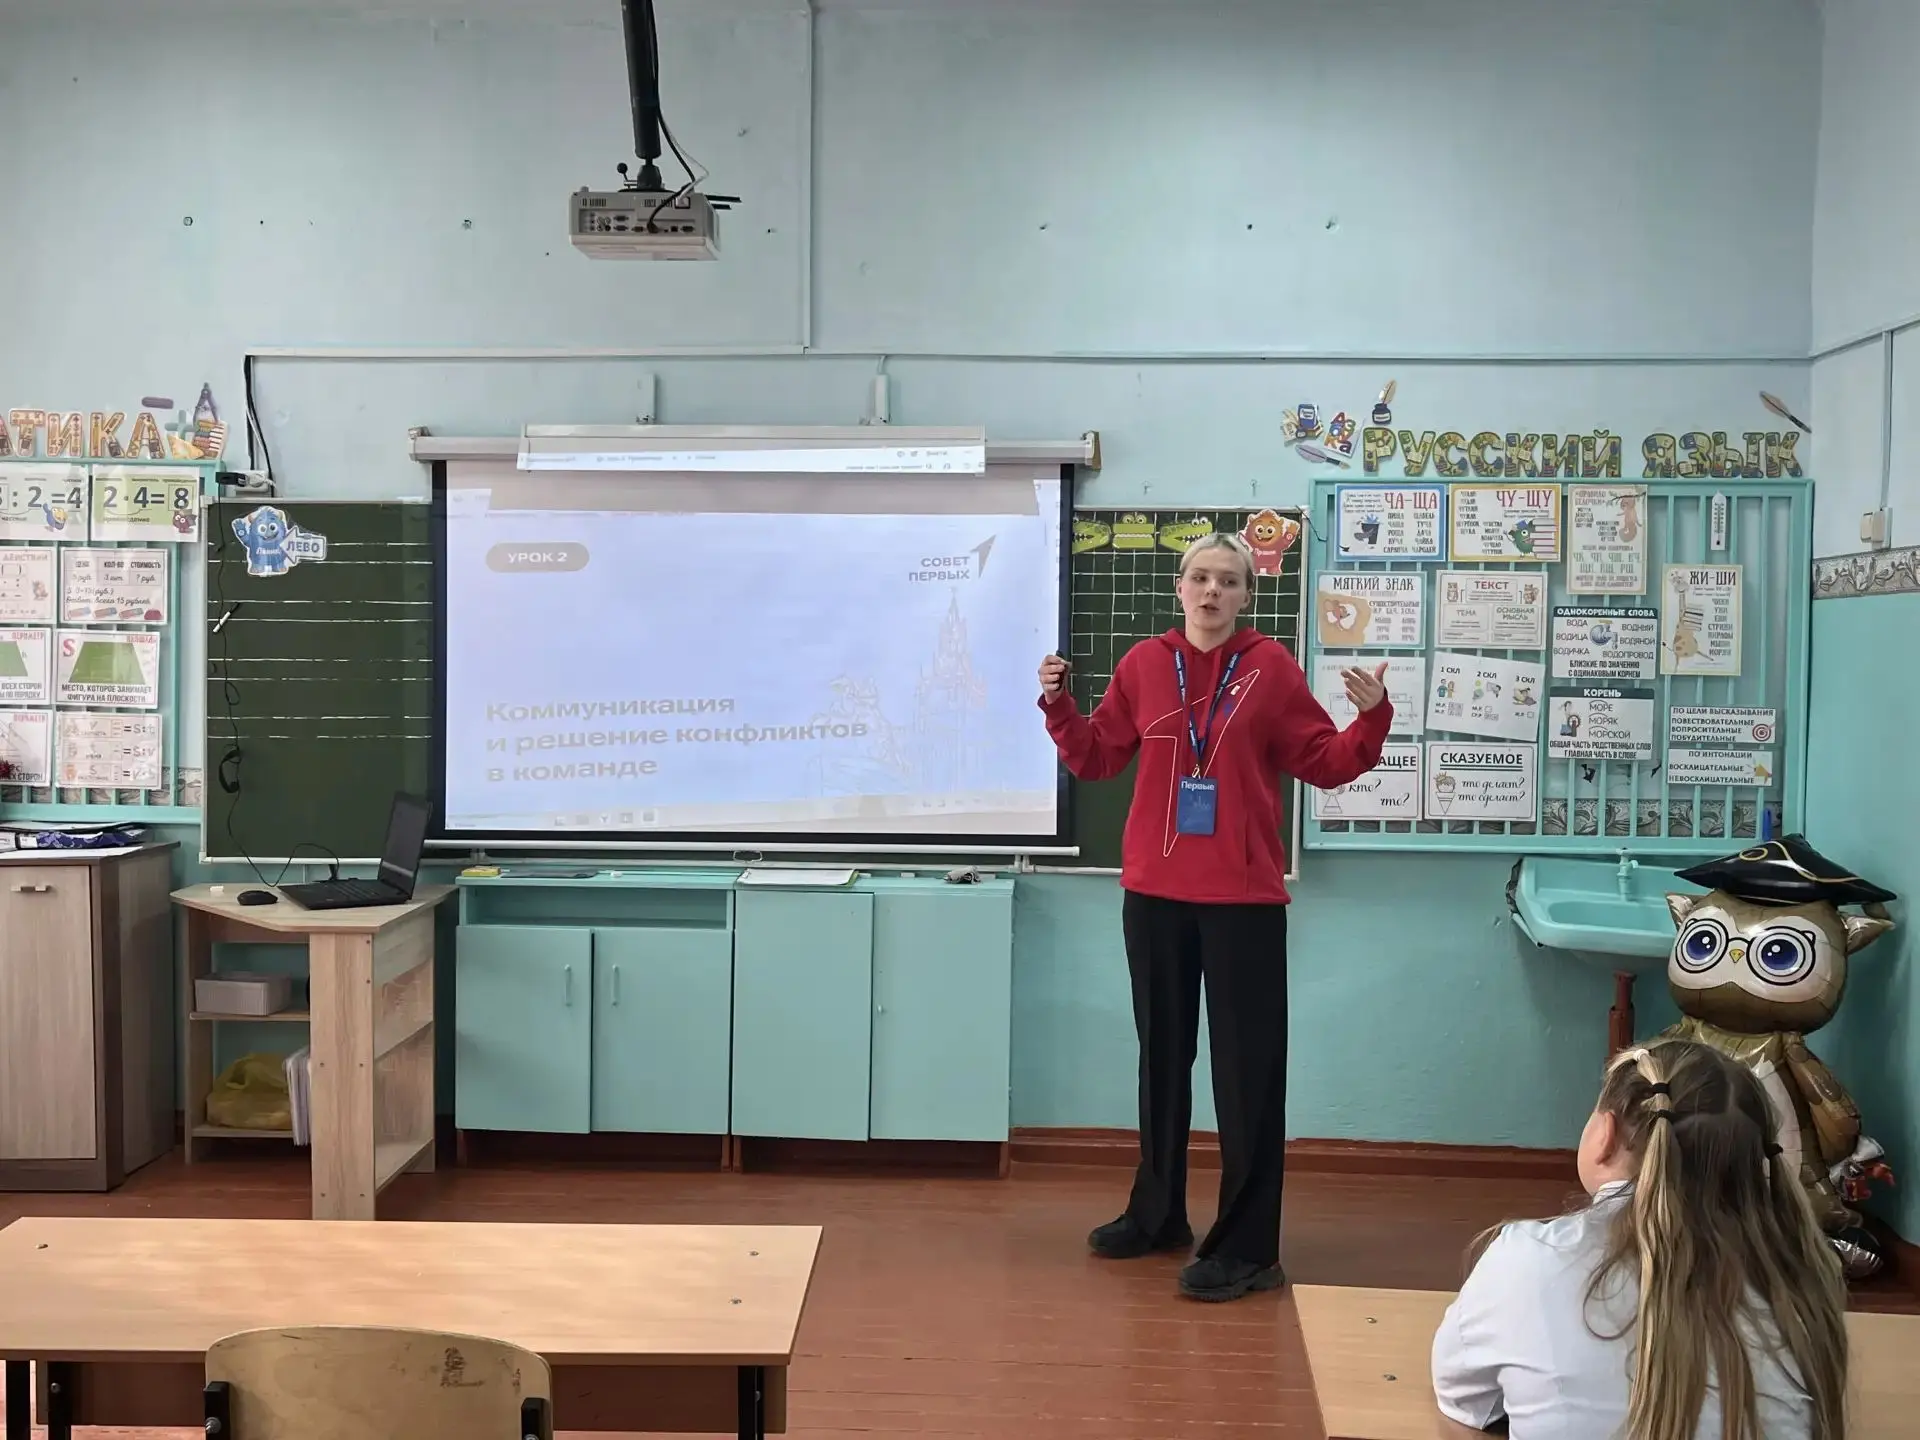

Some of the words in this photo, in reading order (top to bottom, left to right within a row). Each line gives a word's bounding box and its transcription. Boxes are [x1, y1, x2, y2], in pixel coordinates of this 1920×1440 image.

[1362, 427, 1622, 477] РУССКИЙ
[1642, 431, 1802, 477] ЯЗЫК
[287, 541, 320, 553] ЛЕВО
[508, 553, 553, 563] УРОК
[557, 552, 567, 562] 2
[921, 556, 970, 567] СОВЕТ
[909, 570, 970, 581] ПЕРВЫХ
[1333, 576, 1380, 590] МЯГКИЙ
[1386, 578, 1414, 590] ЗНАК
[1474, 581, 1509, 590] ТЕКСТ
[1456, 609, 1477, 617] ТЕМА
[1557, 608, 1625, 616] ОДНОКОРЕННЫЕ
[1621, 623, 1654, 631] ВОДНЫЙ
[1556, 633, 1588, 641] ВОДИЦА
[1619, 637, 1655, 645] ВОДЯНОЙ
[63, 638, 75, 657] S
[1553, 647, 1590, 655] ВОДИЧКА
[1602, 651, 1654, 659] ВОДОПРОВОД
[1569, 660, 1598, 668] БЛИЗКИЕ
[1521, 676, 1535, 684] СКЛ
[1583, 689, 1621, 697] КОРЕНЬ
[487, 698, 735, 721] Коммуникация
[1709, 708, 1773, 716] ВЫСКАЗЫВАНИЯ
[1589, 717, 1618, 725] МОРЯК
[1589, 730, 1631, 738] МОРСКОЙ
[486, 737, 506, 752] и
[516, 728, 669, 755] решение
[676, 723, 868, 746] конфликтов
[1592, 742, 1635, 750] РОДСТВЕННЫХ
[1564, 750, 1592, 758] ГЛАВНАЯ
[1378, 756, 1416, 768] АЩЕЕ
[1441, 752, 1523, 765] СКАЗУЕМОЕ
[487, 768, 504, 781] в
[514, 760, 658, 781] команде
[1669, 764, 1744, 772] ВОСКЛИЦАТЕЛЬНЫЕ
[1181, 780, 1215, 791] Первые
